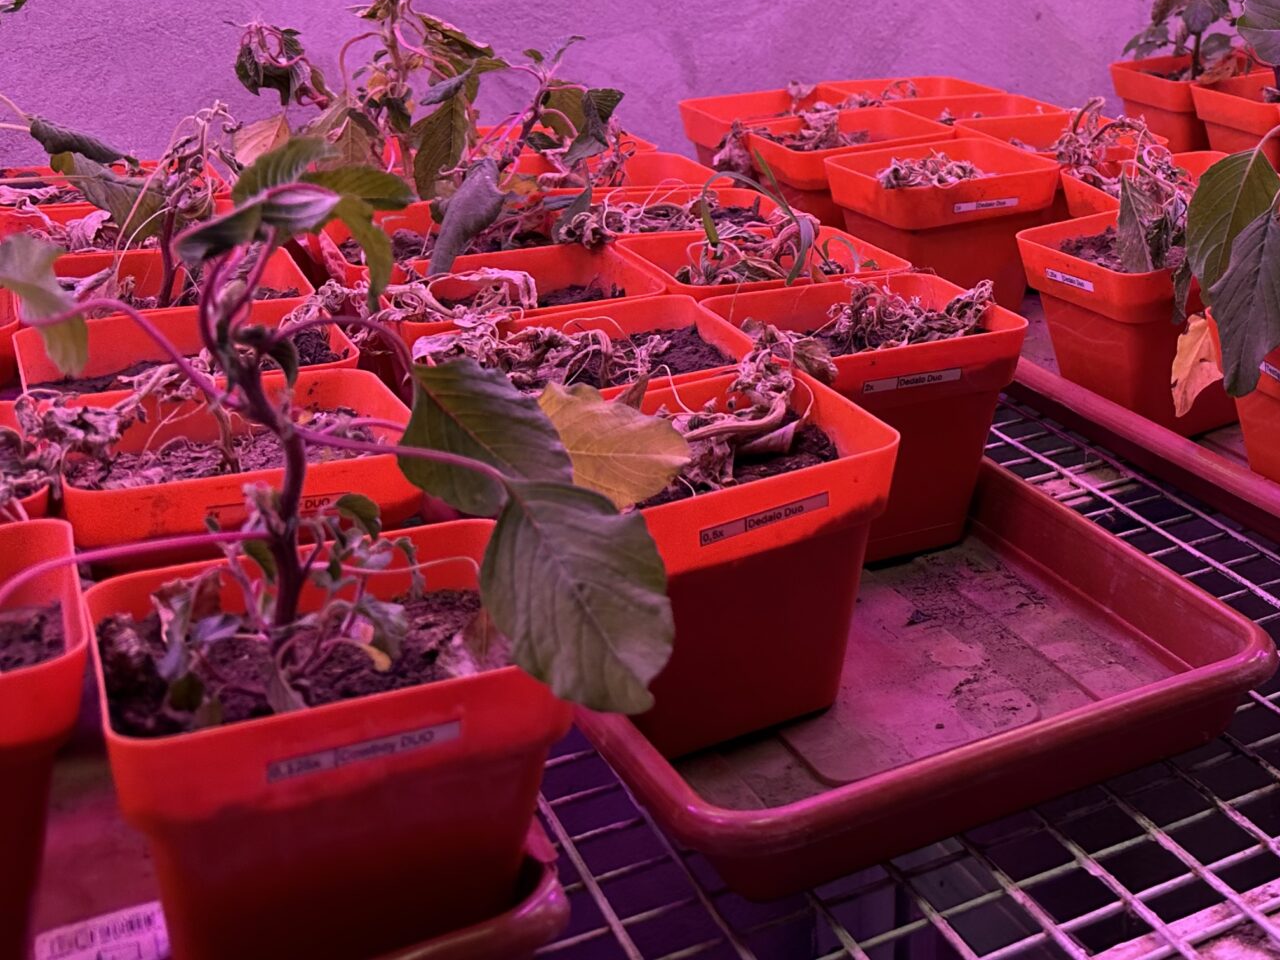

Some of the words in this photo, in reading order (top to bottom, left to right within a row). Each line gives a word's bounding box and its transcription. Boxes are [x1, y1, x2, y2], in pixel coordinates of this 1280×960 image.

[927, 374, 943, 383] Duo
[748, 511, 782, 529] Dedalo
[784, 504, 804, 517] Duo
